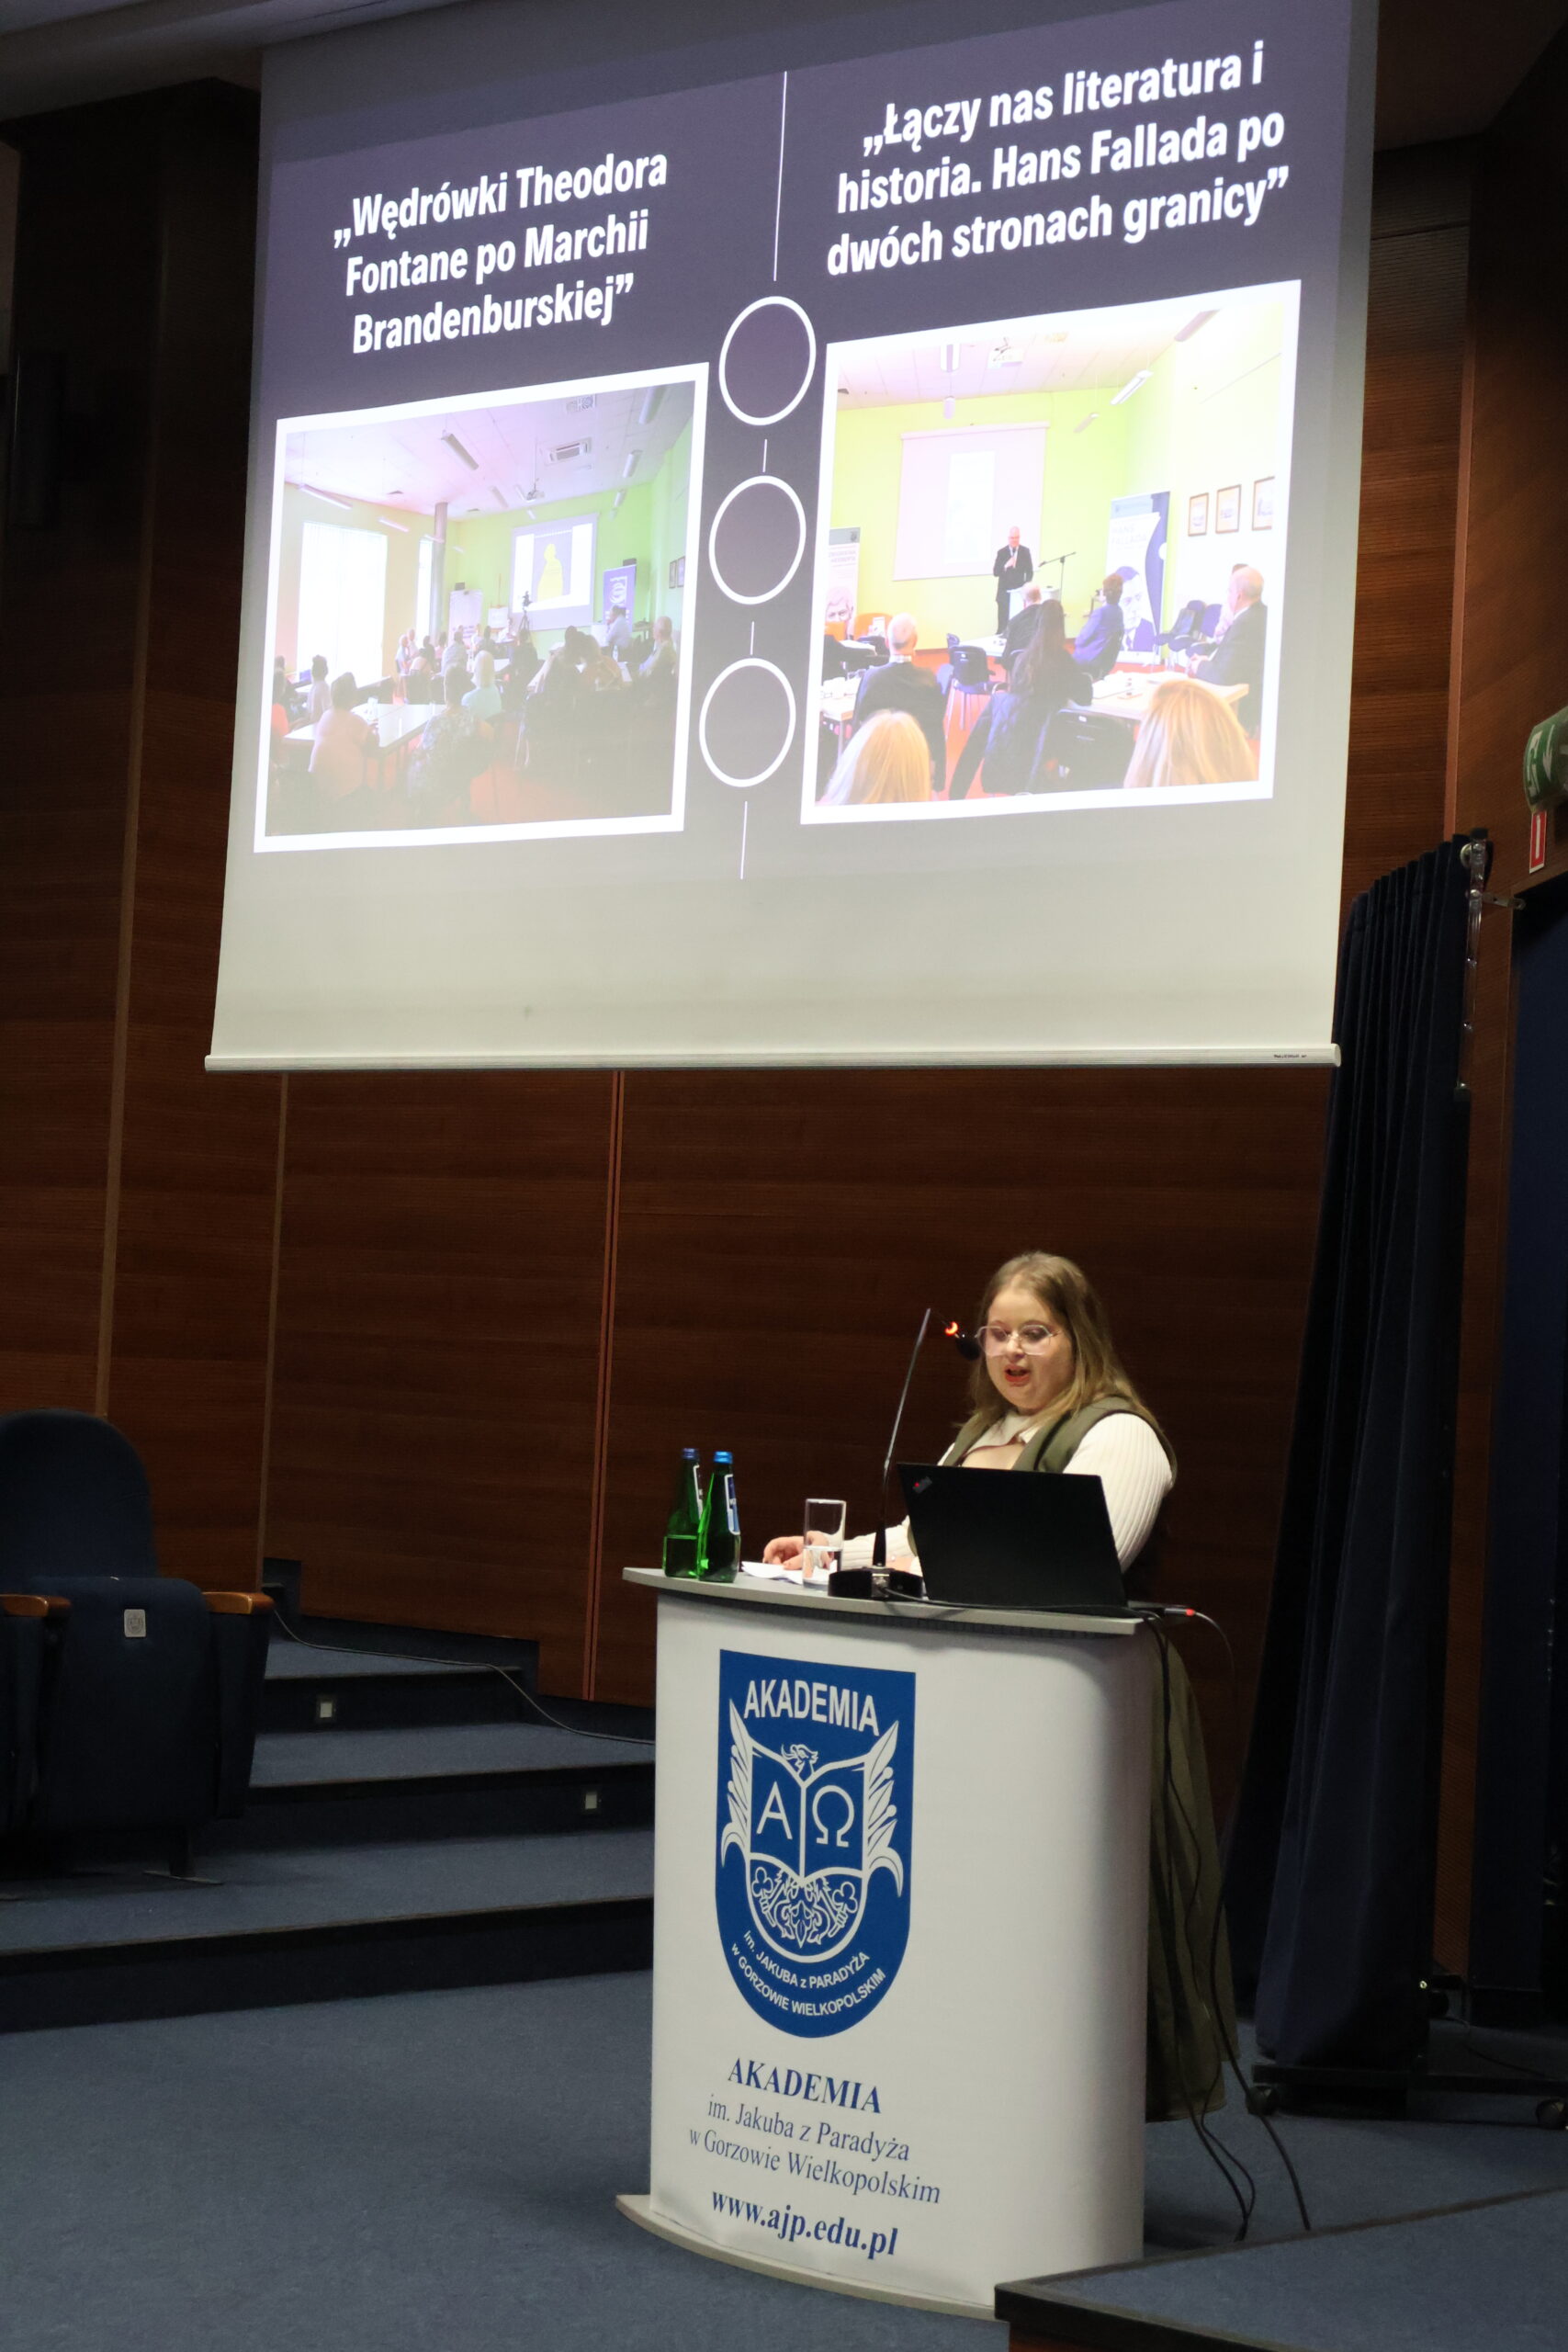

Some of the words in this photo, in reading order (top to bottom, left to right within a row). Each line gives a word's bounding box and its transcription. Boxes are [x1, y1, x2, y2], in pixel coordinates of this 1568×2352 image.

[863, 96, 982, 157] „Łączy
[989, 85, 1054, 127] nas
[1063, 53, 1241, 115] literatura
[1252, 40, 1264, 85] i
[838, 157, 982, 213] historia.
[992, 144, 1081, 190] Hans
[1090, 115, 1227, 174] Fallada
[1237, 112, 1284, 163] po
[333, 173, 507, 249] „Wędrówki
[515, 153, 668, 209] Theodora
[827, 220, 942, 275] dwóch
[952, 195, 1112, 257] stronach
[1123, 165, 1290, 243] granicy”
[345, 244, 468, 296] Fontane
[476, 238, 515, 284] po
[524, 209, 649, 268] Marchii
[353, 273, 634, 354] Brandenburskiej”
[743, 1679, 880, 1736] AKADEMIA
[812, 1784, 855, 1849] Ω
[738, 1955, 790, 2010] GORZOWIE
[791, 1968, 886, 2017] WIELKOPOLSKIM
[755, 1951, 797, 1987] JAKUBA
[809, 1951, 870, 1989] PARADYŻA
[728, 2057, 881, 2114] AKADEMIA
[707, 2093, 730, 2122] im.
[735, 2103, 795, 2139] Jakuba
[799, 2125, 812, 2142] z
[817, 2122, 910, 2162] Paradyża
[689, 2128, 701, 2146] w
[705, 2129, 781, 2171] Gorzowie
[787, 2151, 942, 2204] Wielkopolskim
[712, 2191, 898, 2260] www.ajp.edu.pl
